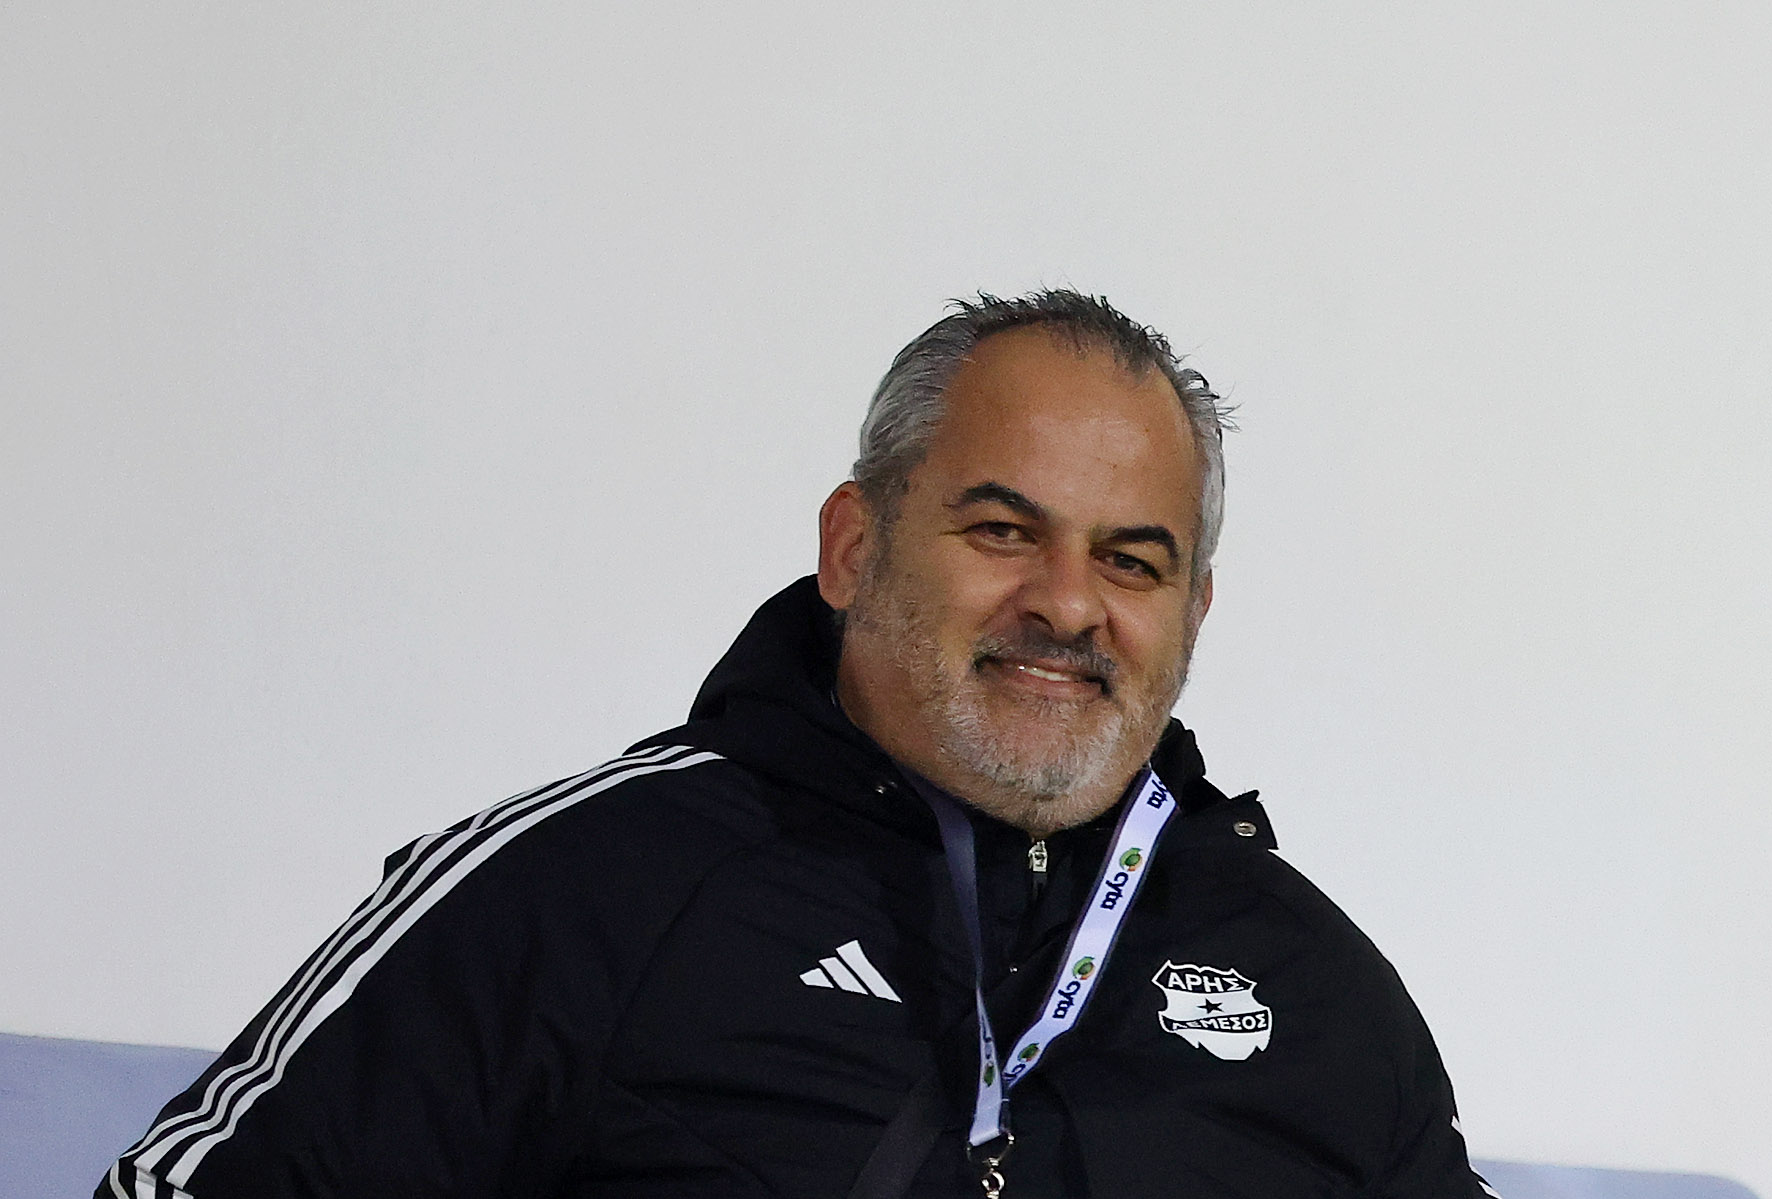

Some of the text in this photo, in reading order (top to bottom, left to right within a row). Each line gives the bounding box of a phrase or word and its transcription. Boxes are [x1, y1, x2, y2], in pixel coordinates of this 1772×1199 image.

[1147, 779, 1168, 809] yta
[1100, 872, 1129, 910] cyta
[1167, 971, 1245, 993] ΑΡΗΣ
[1052, 981, 1081, 1019] cyta
